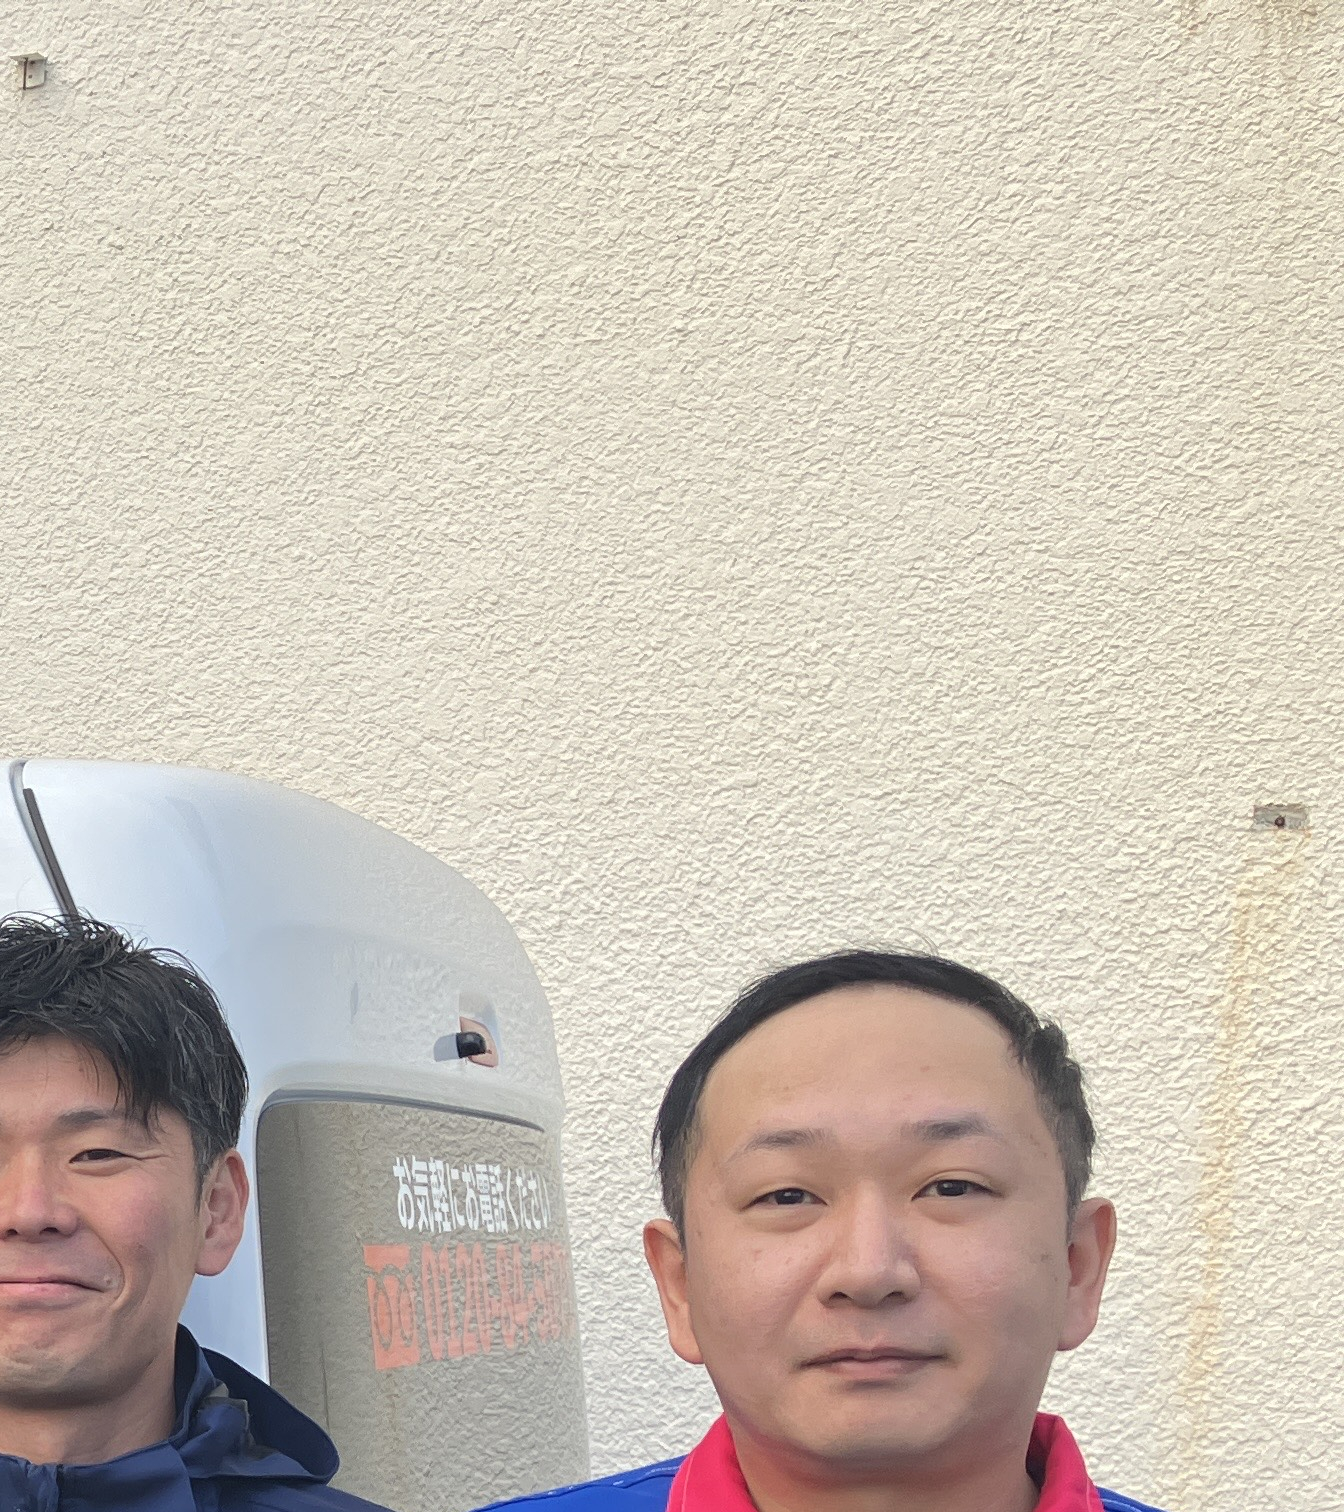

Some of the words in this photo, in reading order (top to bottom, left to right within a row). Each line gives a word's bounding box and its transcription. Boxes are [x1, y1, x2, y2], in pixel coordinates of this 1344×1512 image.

[393, 1155, 551, 1233] お気軽にお電話ください
